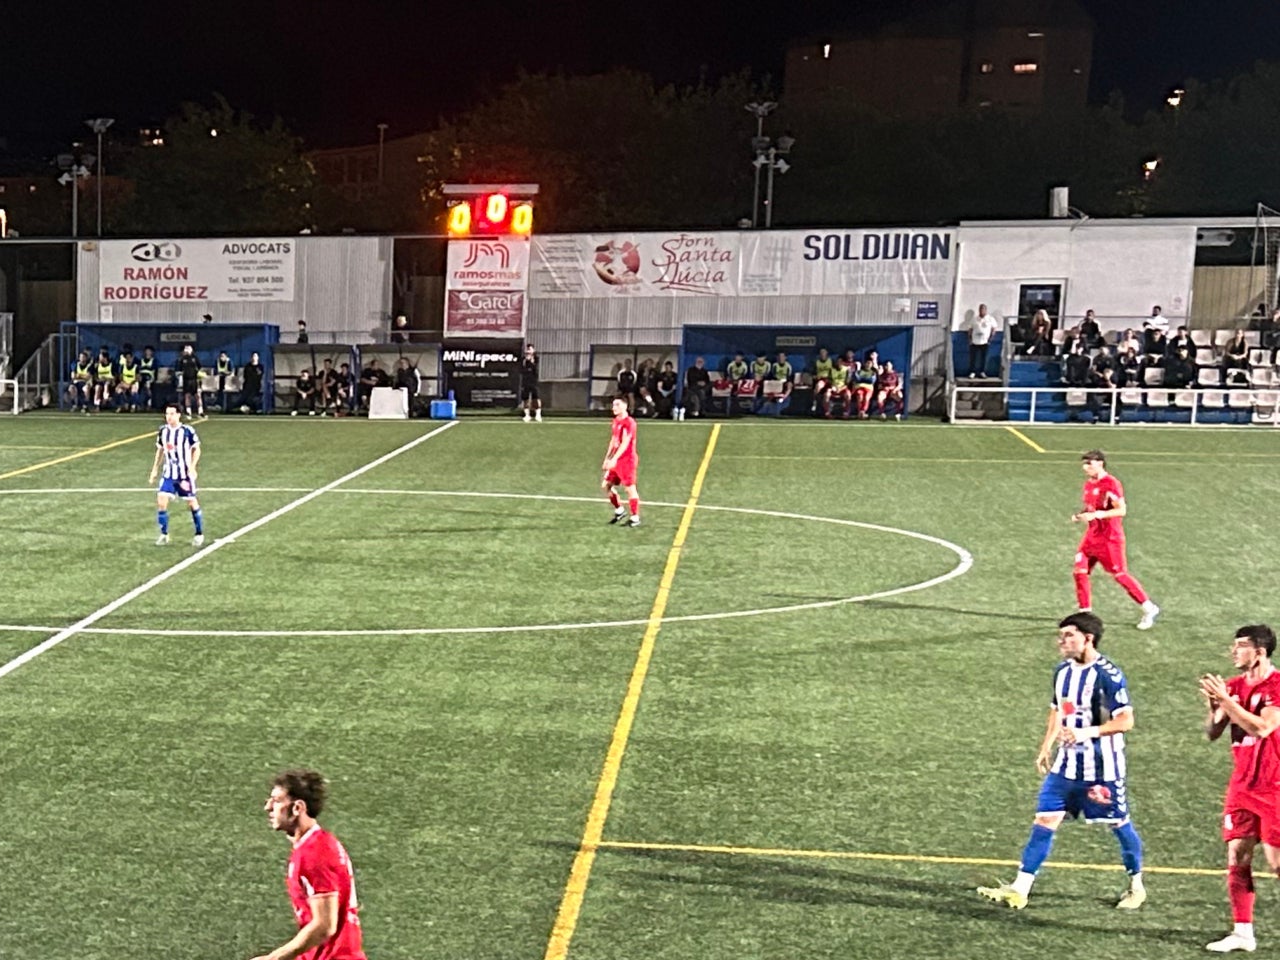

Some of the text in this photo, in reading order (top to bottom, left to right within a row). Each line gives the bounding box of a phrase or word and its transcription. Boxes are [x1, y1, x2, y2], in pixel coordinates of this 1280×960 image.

[222, 243, 291, 254] ADVOCATS
[661, 239, 732, 262] Santa
[123, 264, 189, 281] RAMÓN
[104, 283, 209, 300] RODRÍGUEZ
